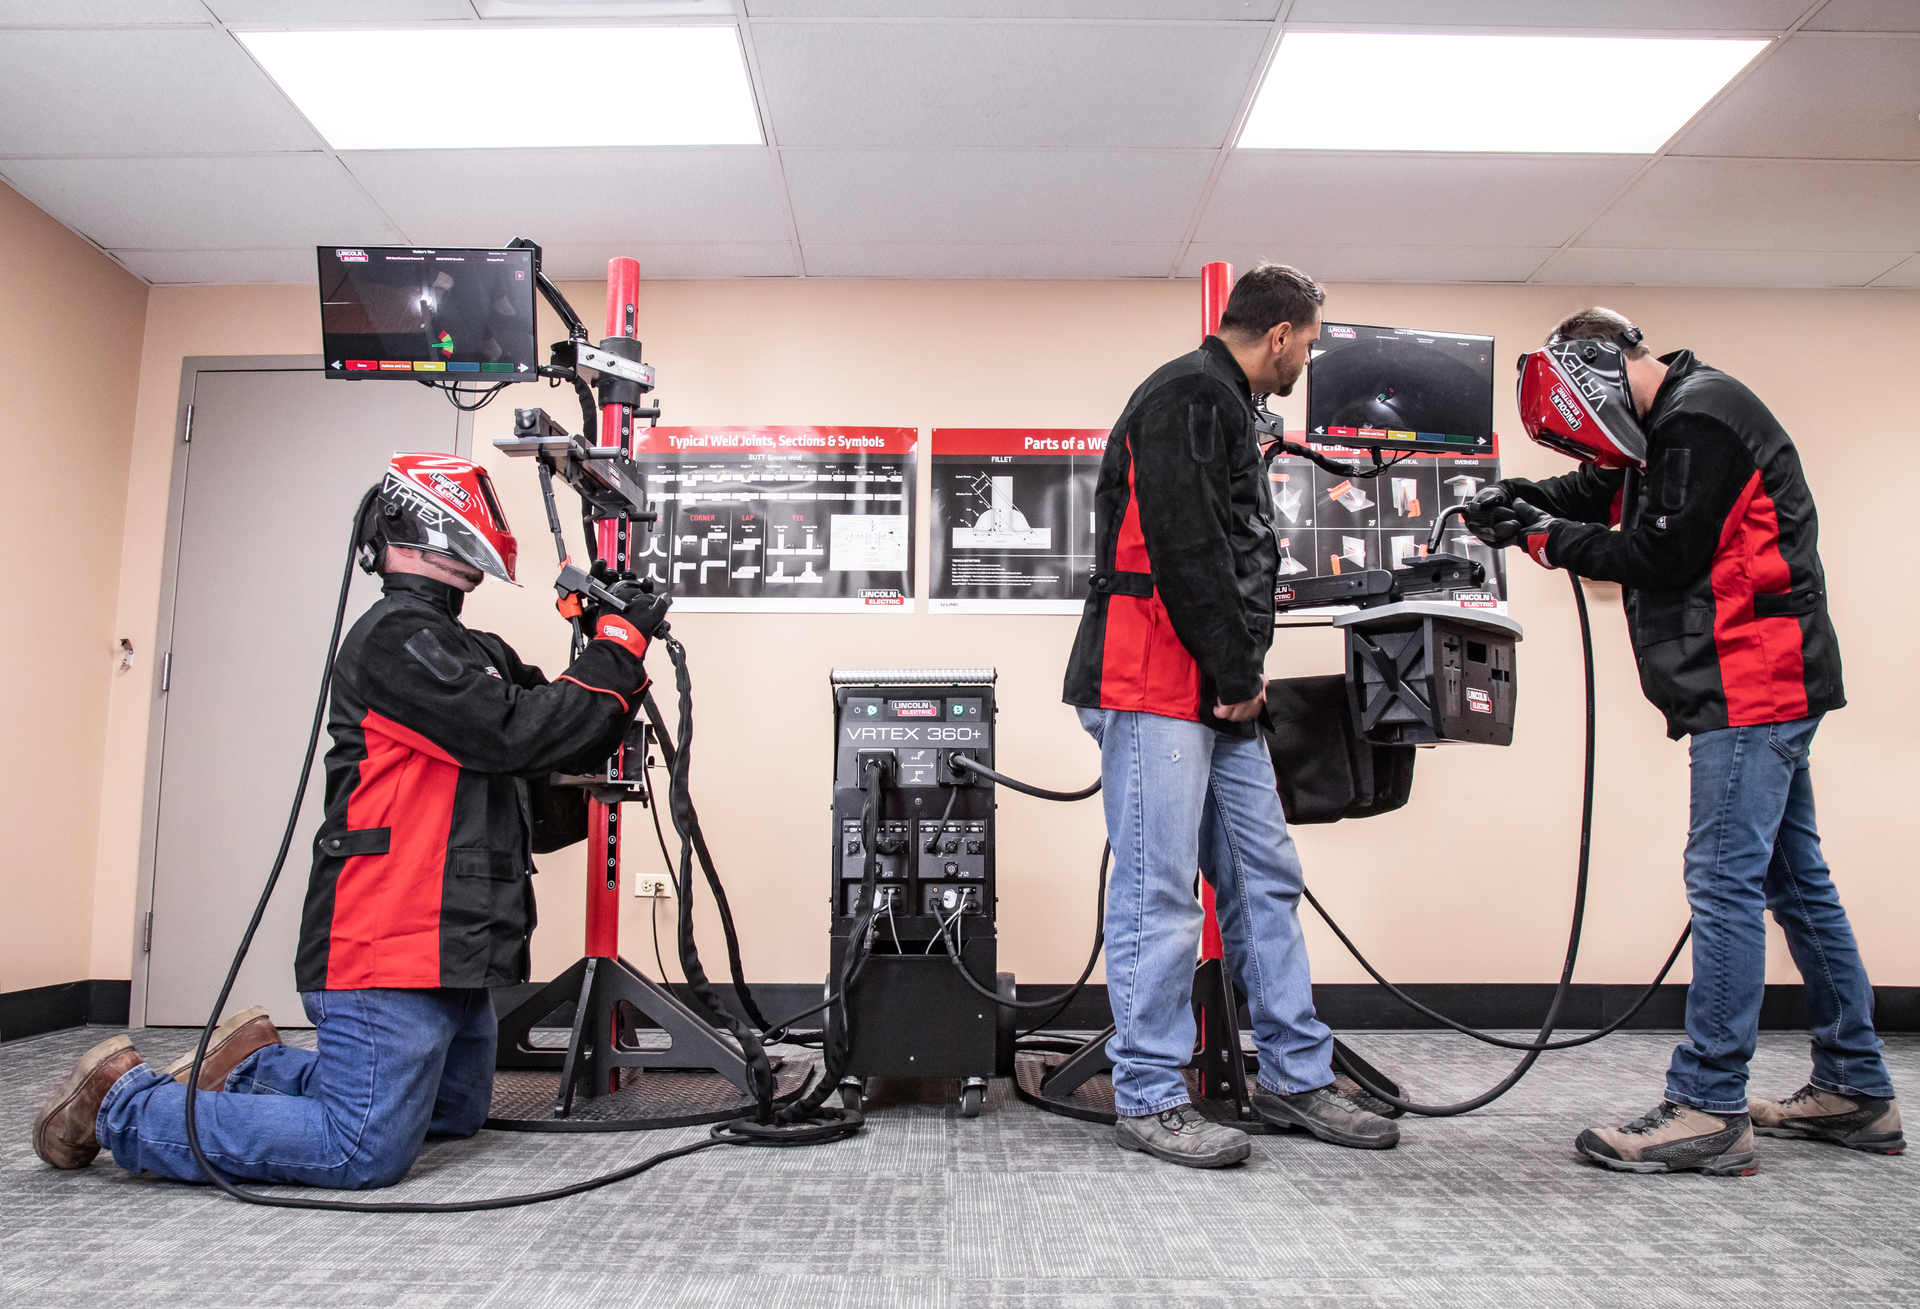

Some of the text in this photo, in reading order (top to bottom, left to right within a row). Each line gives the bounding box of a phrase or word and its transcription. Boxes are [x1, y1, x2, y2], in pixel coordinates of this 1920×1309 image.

[1553, 343, 1608, 412] VRTEX
[1551, 394, 1580, 429] LINCOLN
[1557, 387, 1581, 416] ELECTRIC
[668, 435, 885, 450] Typical Weld Joints, Sections & Symbols
[1024, 436, 1107, 450] Parts of a We
[431, 473, 467, 500] LINCOLN
[434, 484, 466, 509] ELECTRIC
[382, 474, 451, 533] VRTEX
[1467, 689, 1488, 702] LINCOLN
[1472, 701, 1490, 711] ELECTRIC
[846, 727, 982, 741] VRTEX 360+
